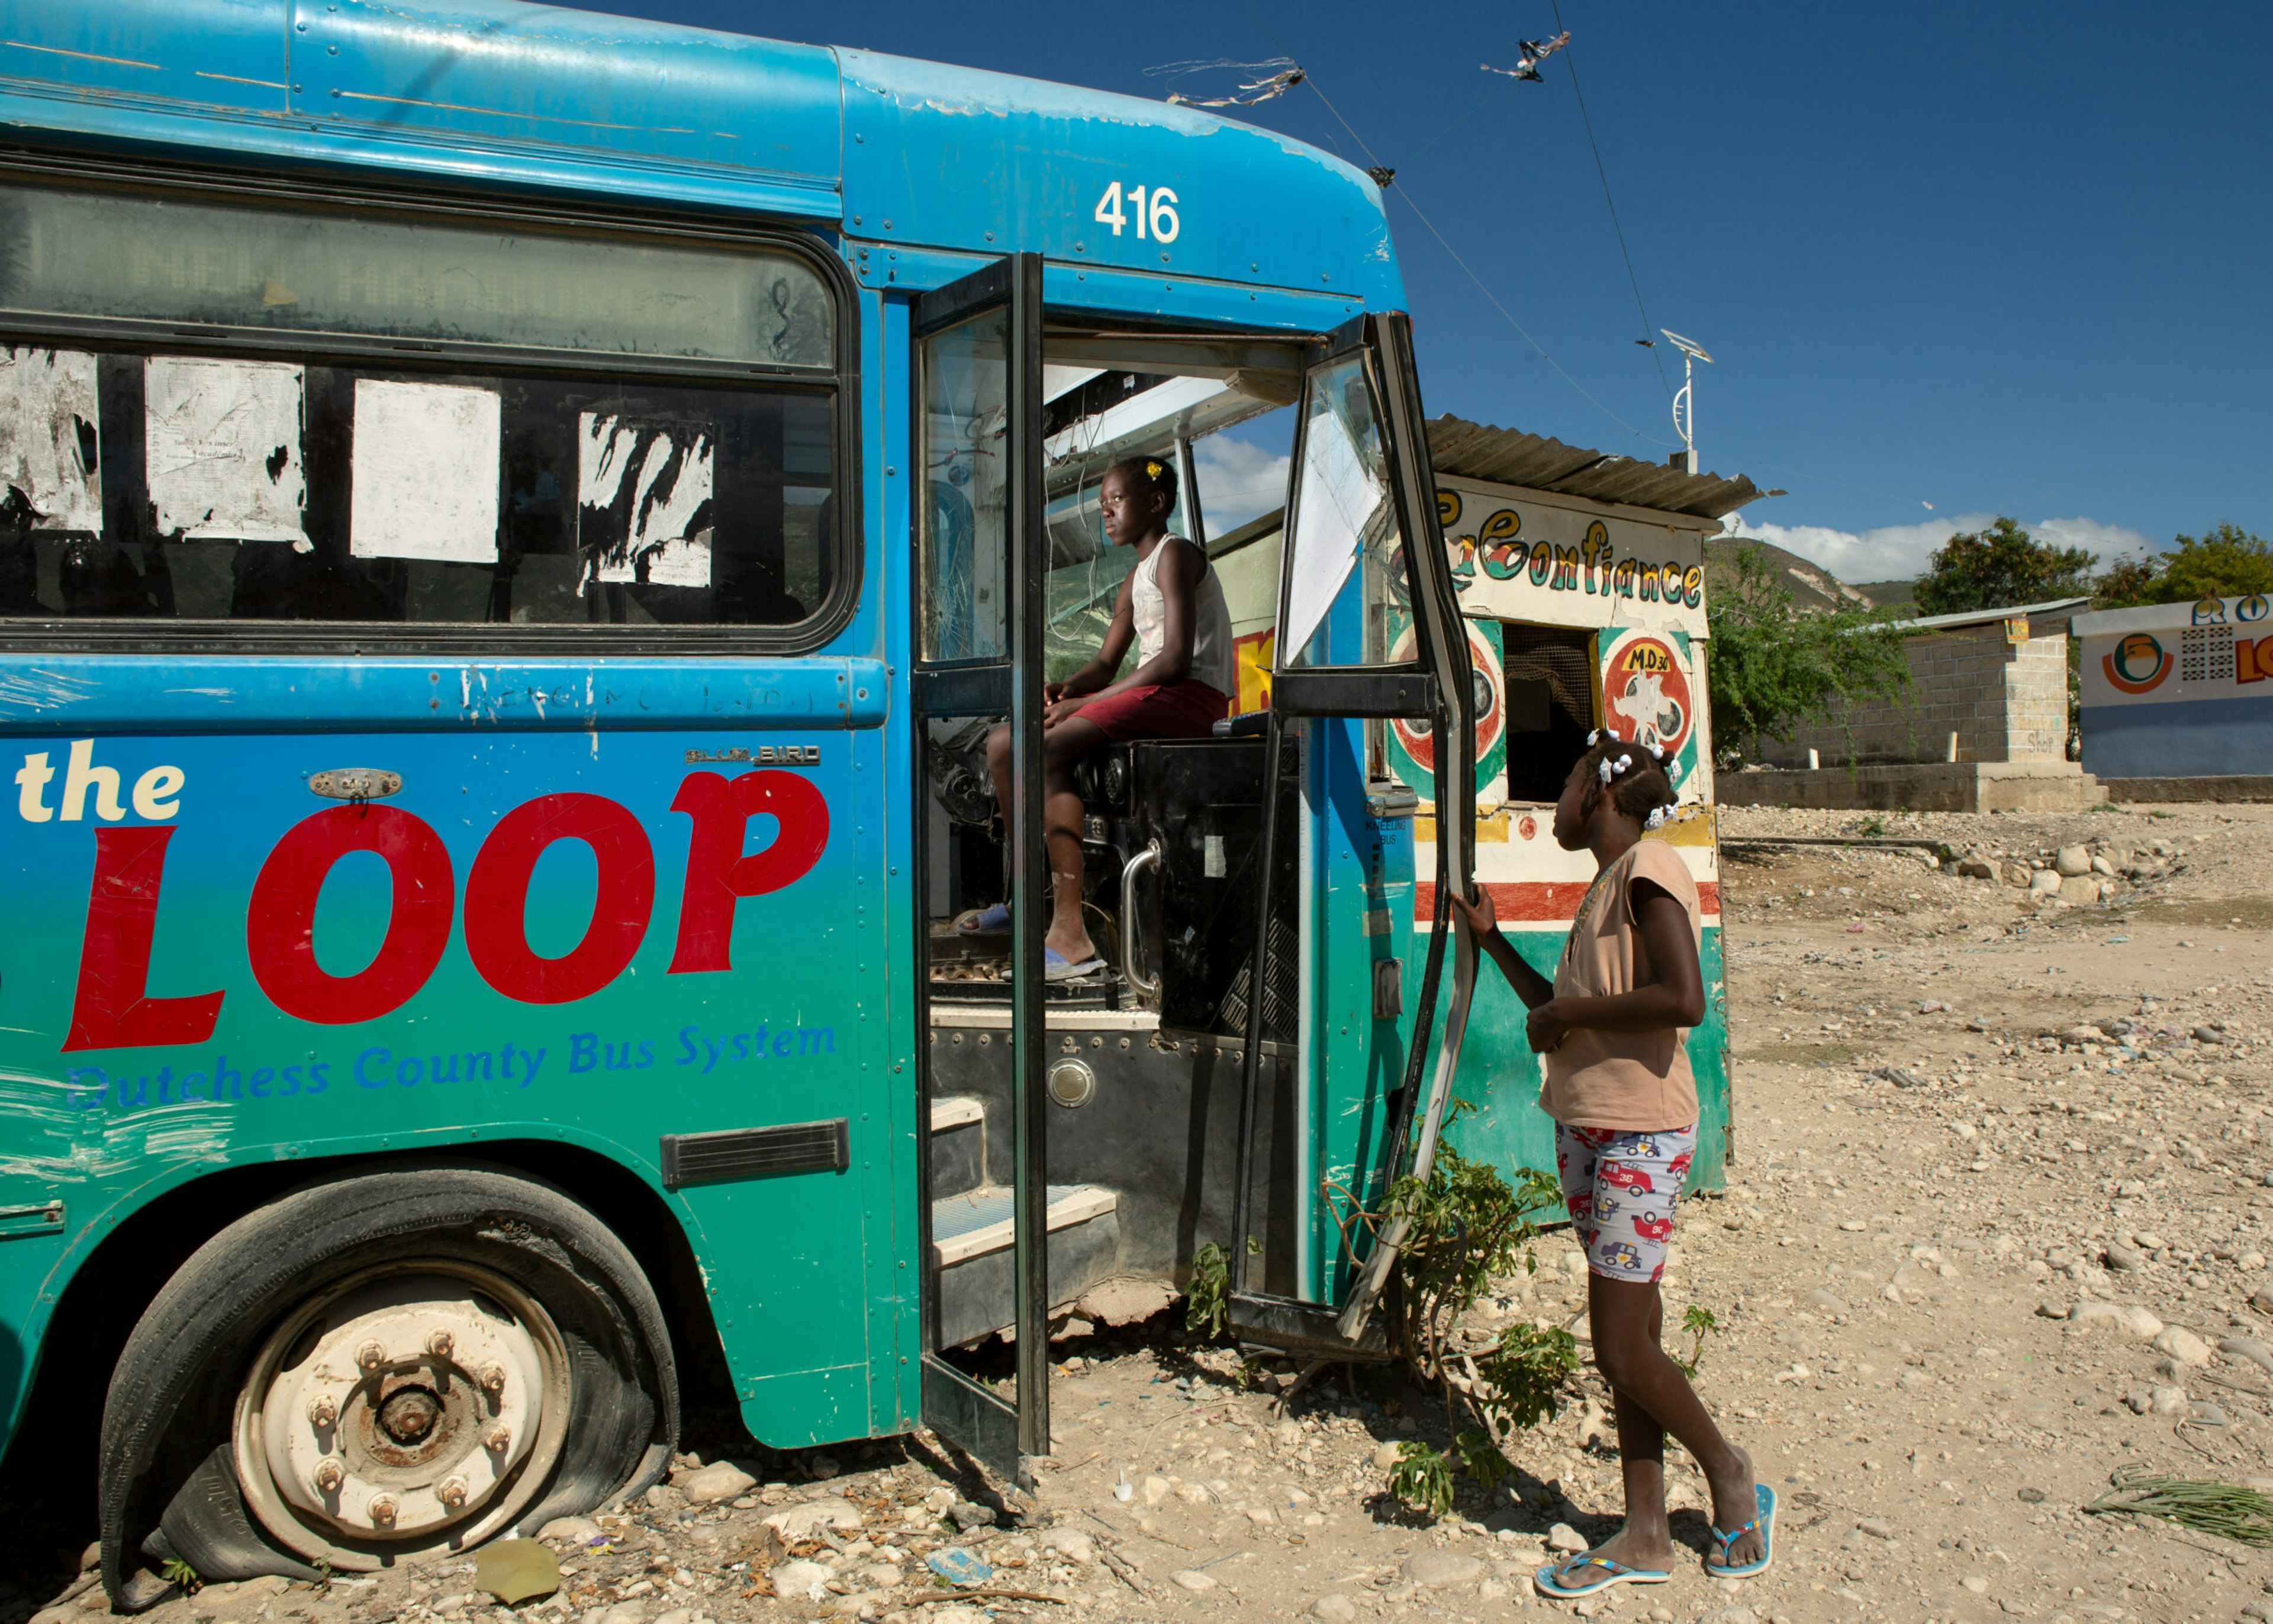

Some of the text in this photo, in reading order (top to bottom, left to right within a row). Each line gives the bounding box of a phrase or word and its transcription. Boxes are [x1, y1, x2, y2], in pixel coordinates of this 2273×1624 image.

[1095, 181, 1180, 243] 416
[1479, 509, 1702, 609] Confiance
[15, 739, 185, 822] the
[757, 746, 820, 763] BIRD
[1366, 820, 1406, 831] KNEELING
[1381, 834, 1396, 845] BUS
[60, 769, 829, 1052] LOOP
[66, 1024, 836, 1110] Dutchess County Bus System
[1620, 1173, 1633, 1183] 36
